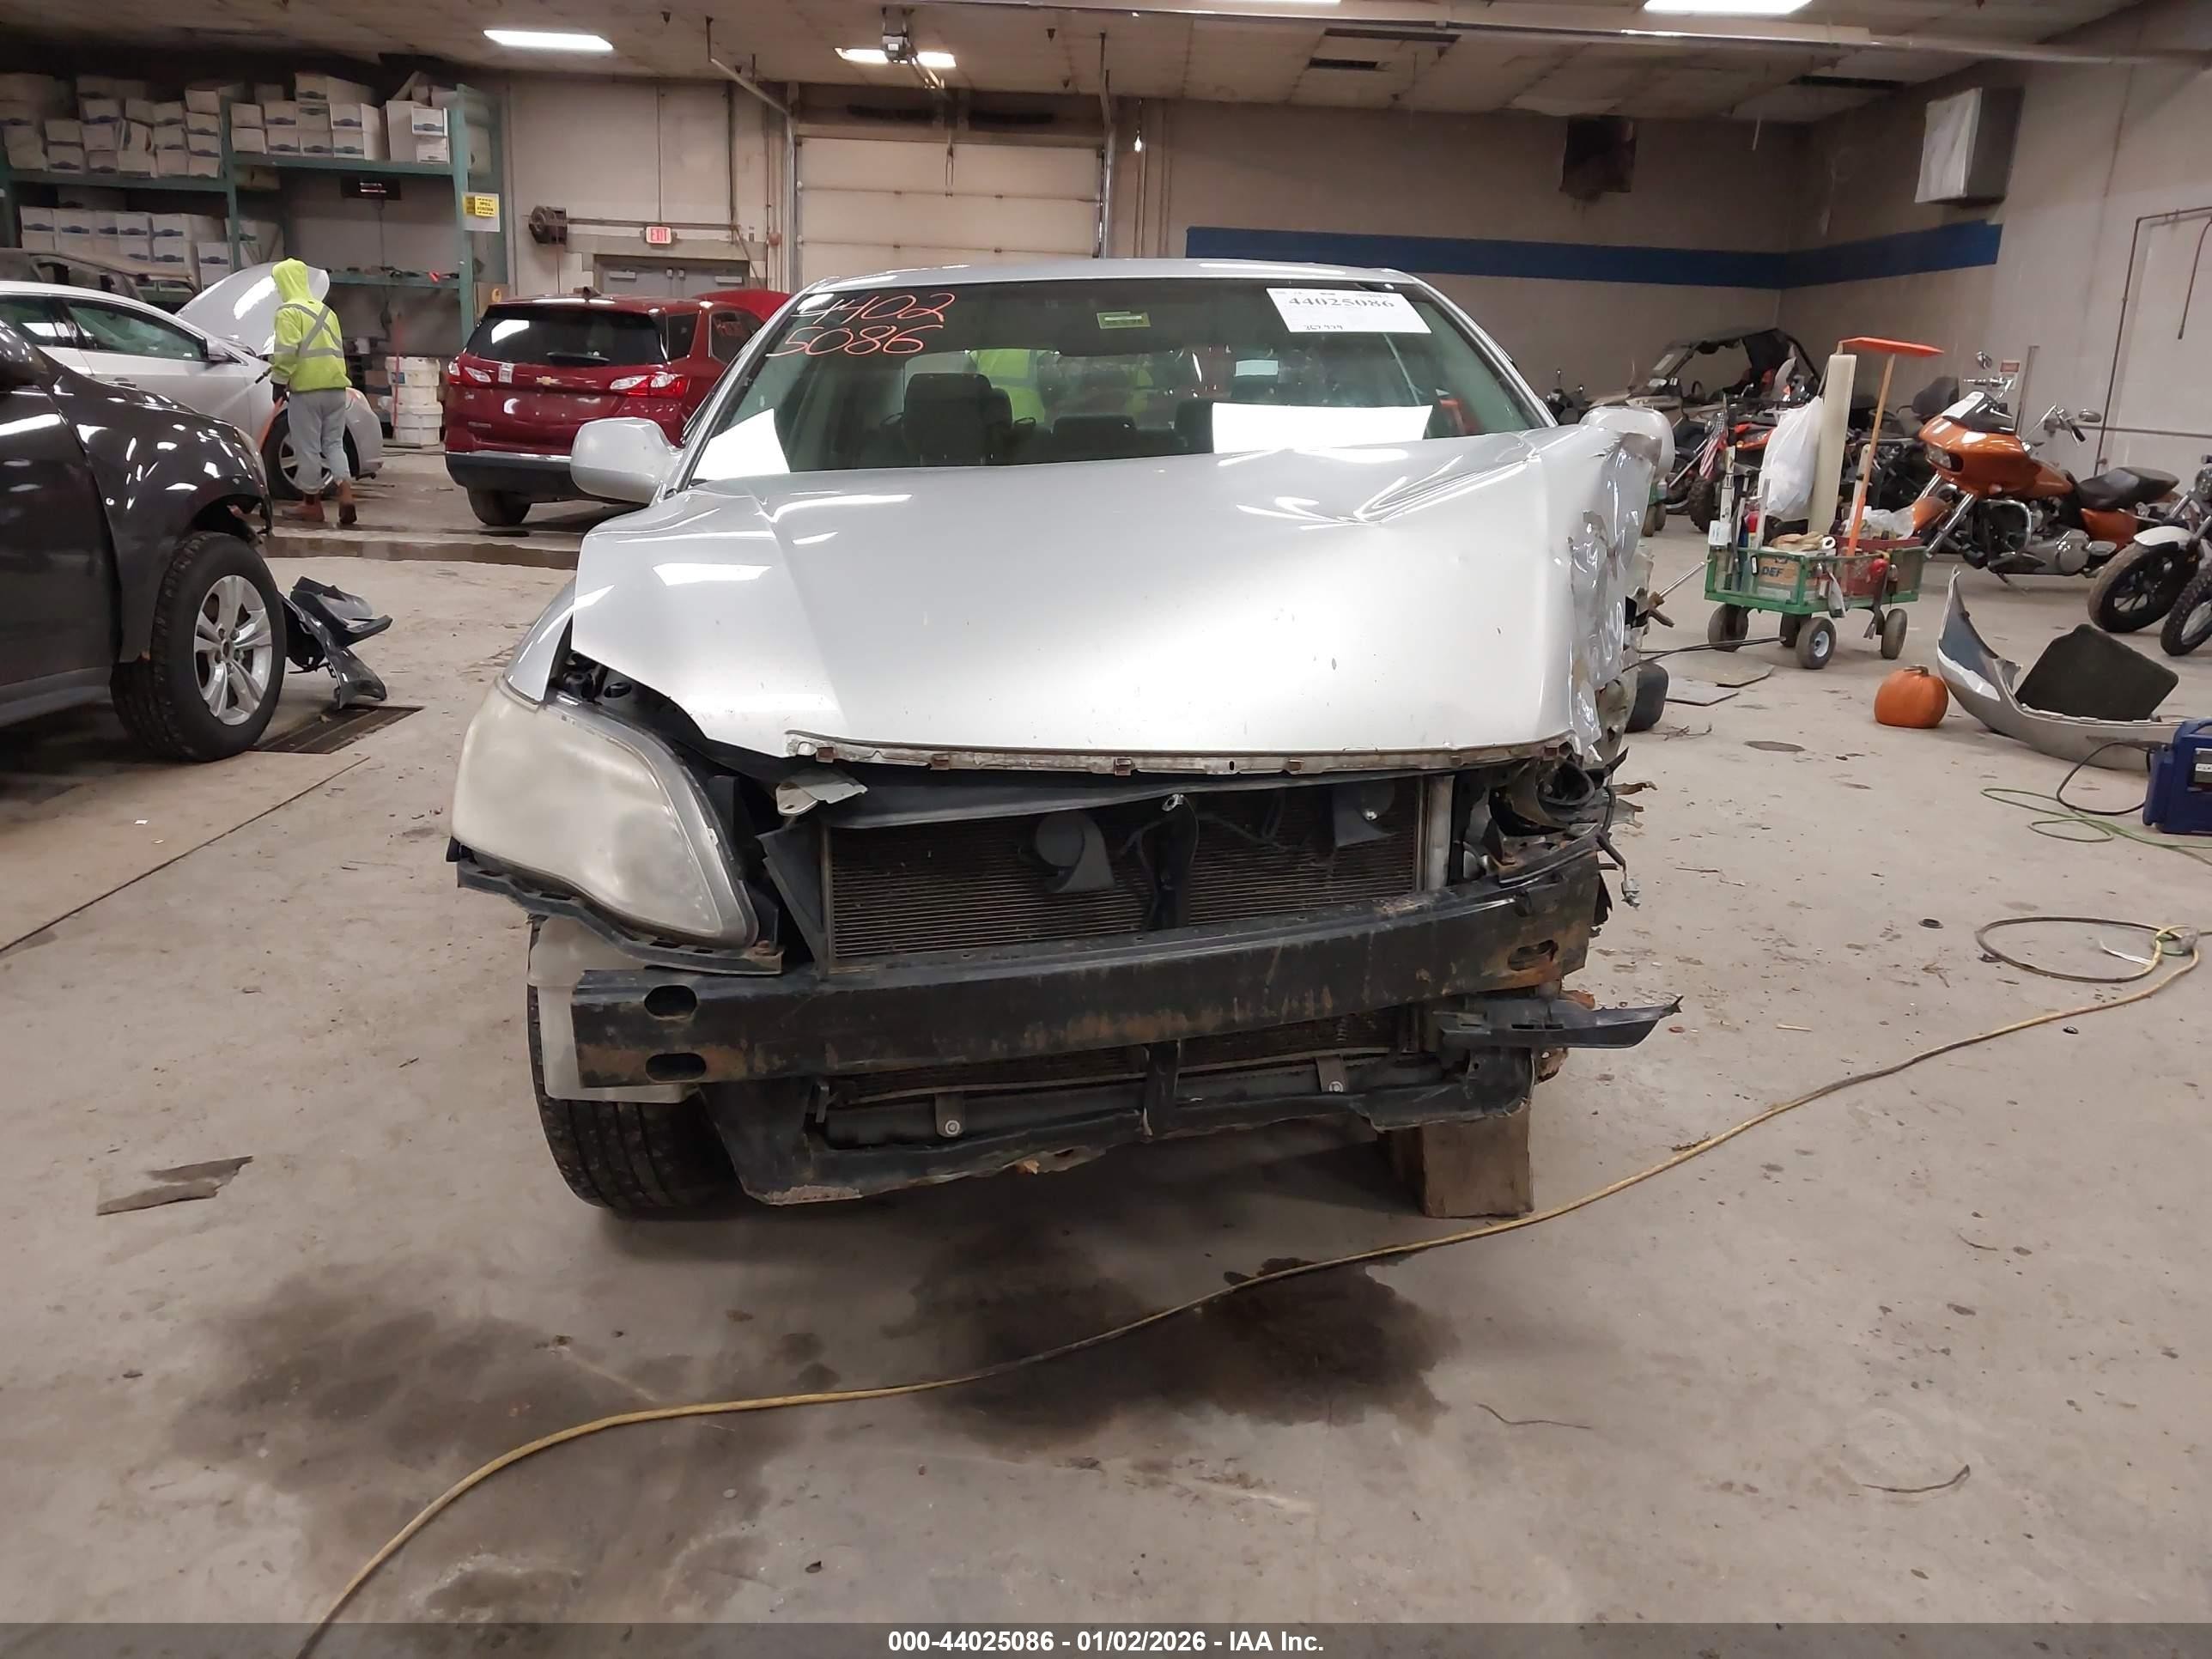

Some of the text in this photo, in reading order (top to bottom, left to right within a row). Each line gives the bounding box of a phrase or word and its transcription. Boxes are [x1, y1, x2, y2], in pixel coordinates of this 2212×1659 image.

[650, 228, 667, 241] EXIT
[790, 293, 956, 325] 4402
[1289, 296, 1395, 308] 44025086
[764, 324, 944, 357] 5086
